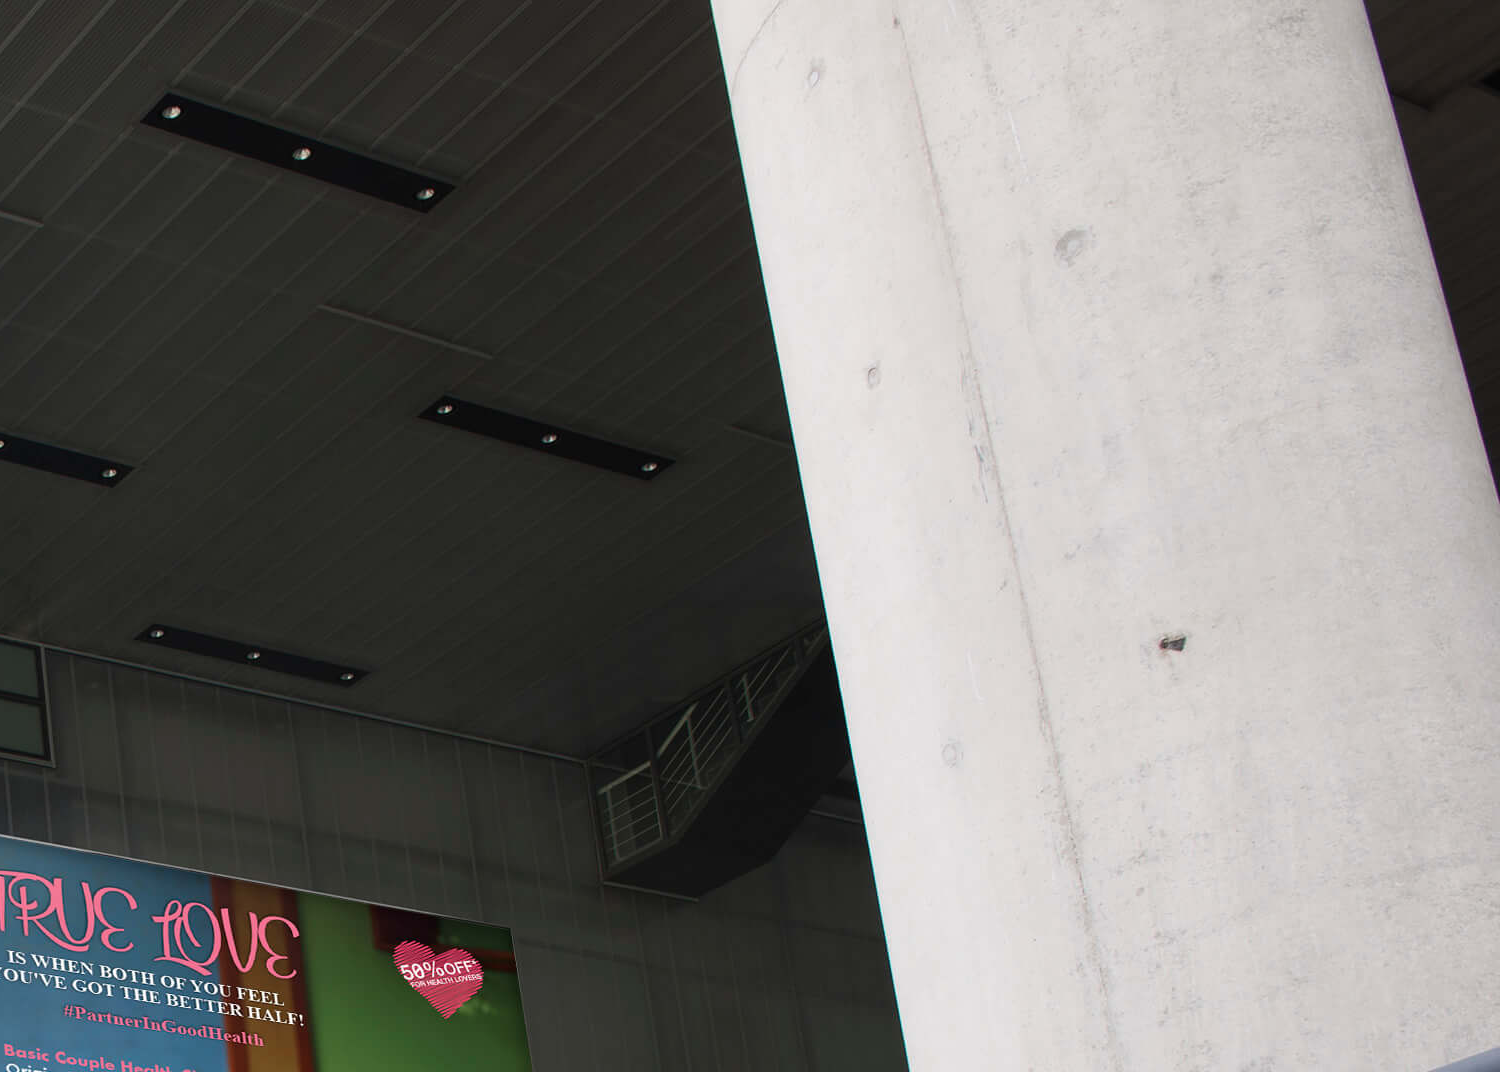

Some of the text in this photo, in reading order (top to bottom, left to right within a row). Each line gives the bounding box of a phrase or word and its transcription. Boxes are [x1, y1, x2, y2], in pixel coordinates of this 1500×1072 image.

[151, 900, 300, 979] LOVE
[6, 950, 285, 1007] IS WHEN BOTH OF YOU FEEL
[426, 977, 454, 986] HEALTH
[455, 973, 482, 983] LOVERS
[72, 978, 117, 997] GOT
[120, 986, 161, 1004] THE
[166, 994, 242, 1018] BETTER
[247, 1006, 305, 1027] HALF!
[63, 1005, 265, 1047] #PartnerInGoodHealth
[4, 1044, 49, 1062] Basic
[55, 1051, 115, 1072] Couple
